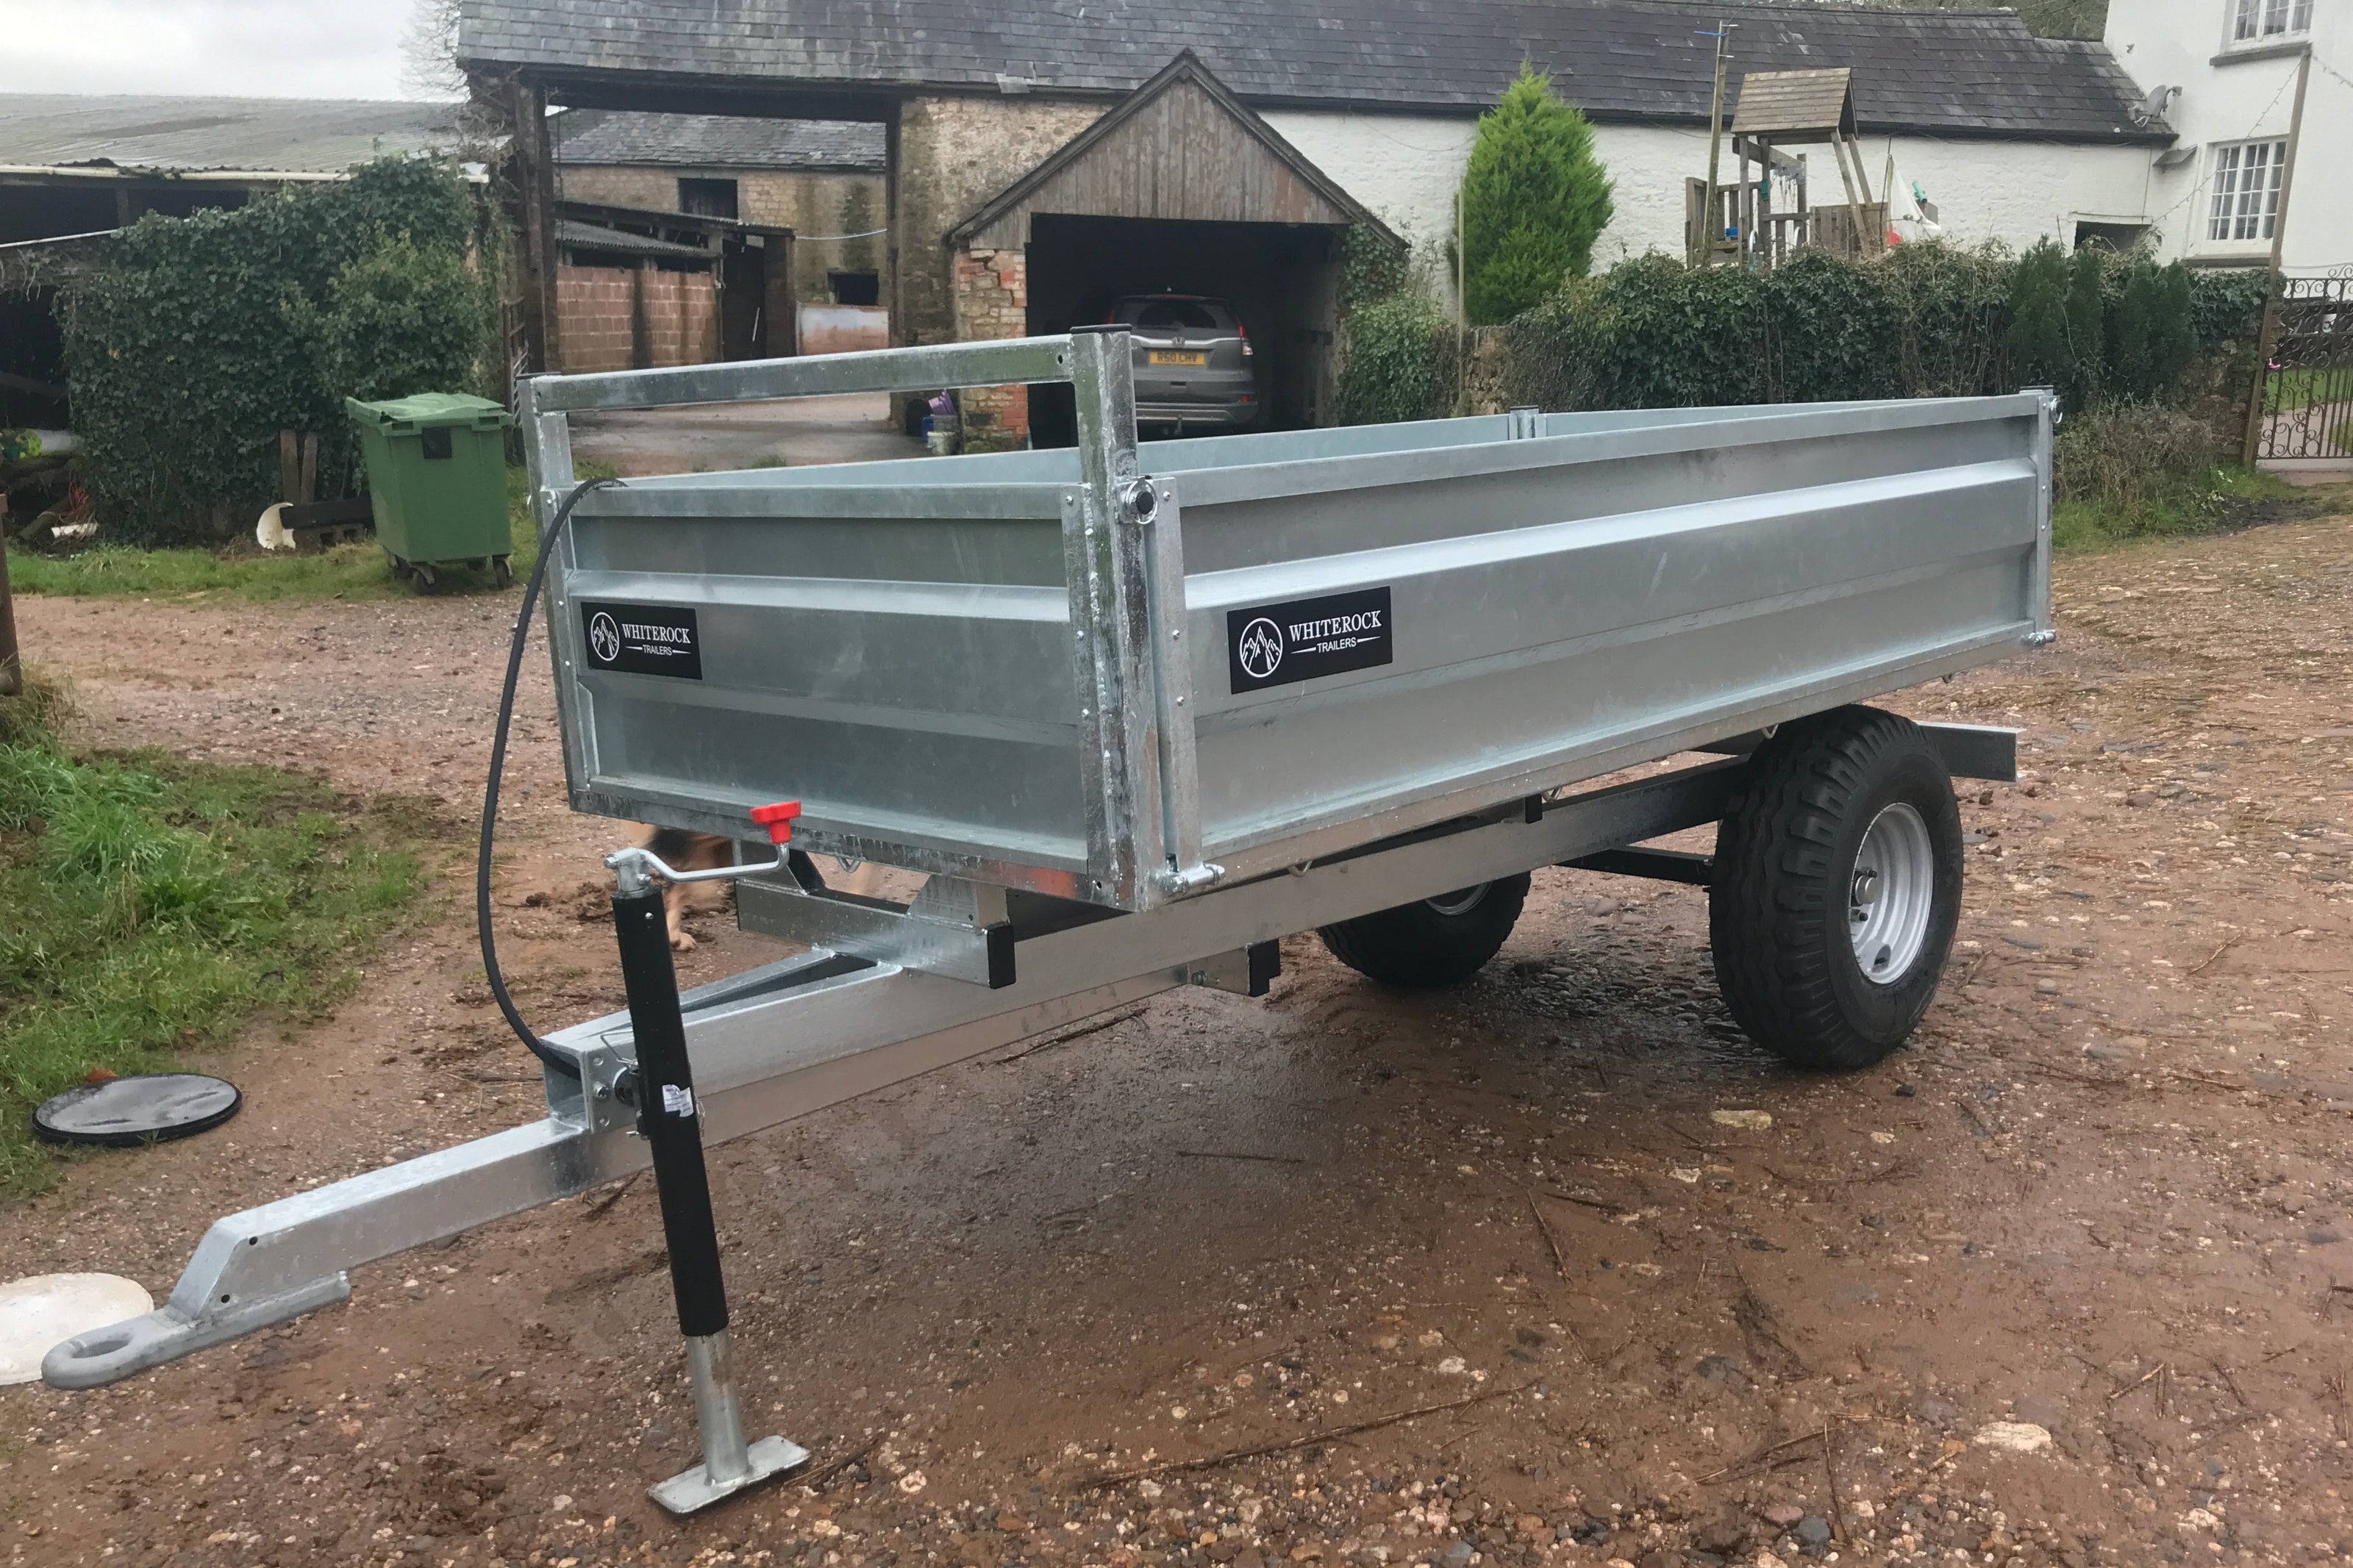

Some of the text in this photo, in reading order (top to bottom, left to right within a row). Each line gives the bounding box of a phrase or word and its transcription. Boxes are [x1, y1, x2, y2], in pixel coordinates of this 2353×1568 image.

[621, 623, 691, 643] WHITEROCK
[1288, 610, 1382, 642] WHITEROCK
[642, 644, 673, 656] TRAILERS
[1317, 637, 1357, 653] TRAILERS
